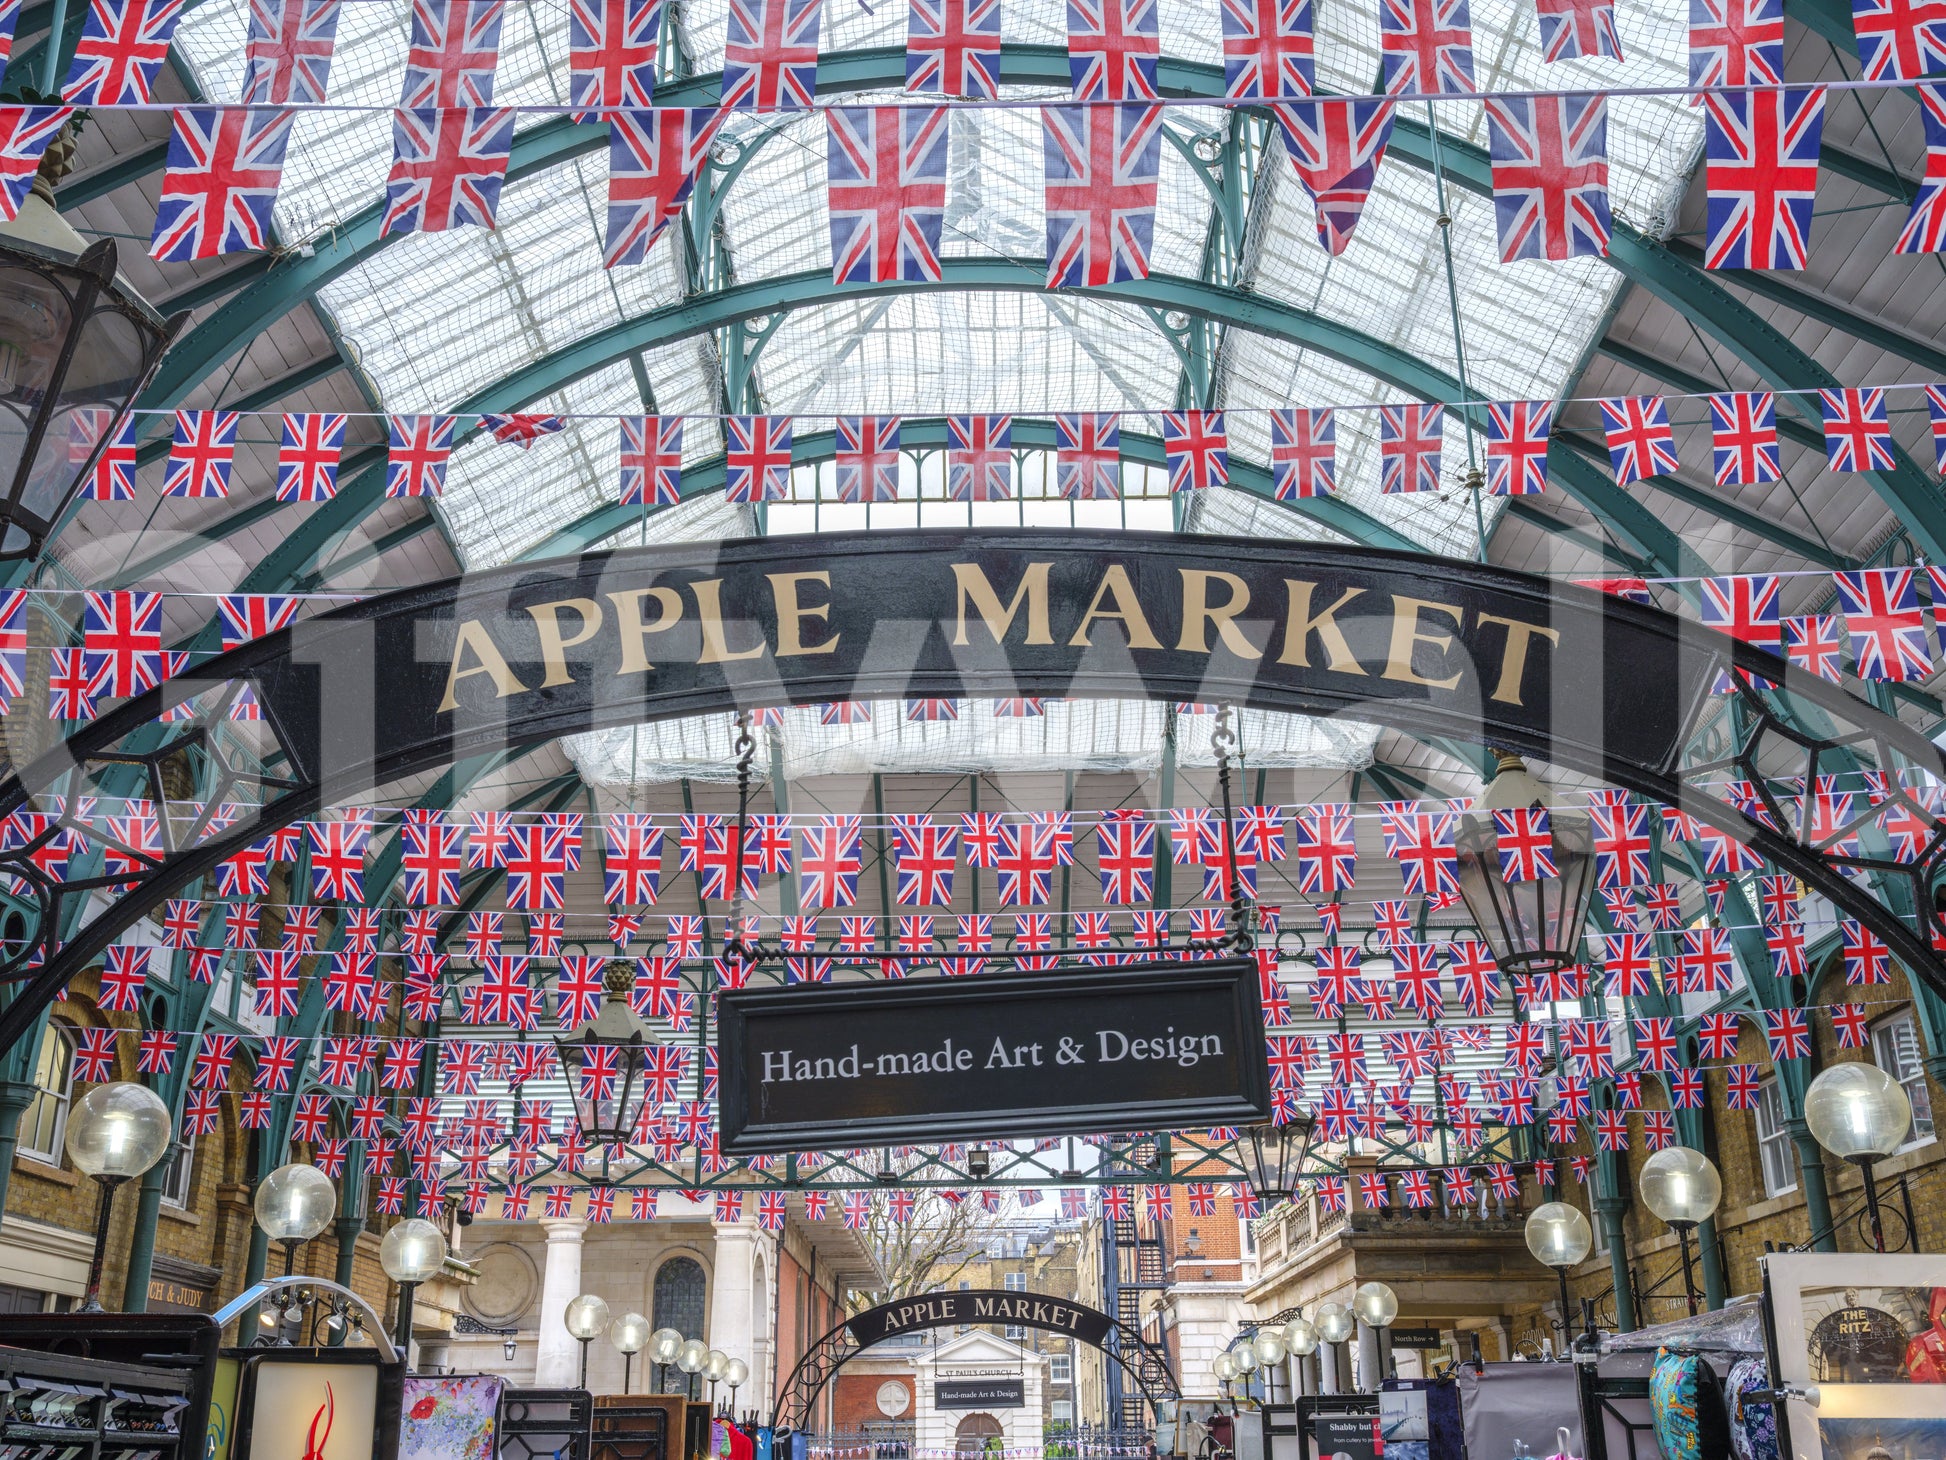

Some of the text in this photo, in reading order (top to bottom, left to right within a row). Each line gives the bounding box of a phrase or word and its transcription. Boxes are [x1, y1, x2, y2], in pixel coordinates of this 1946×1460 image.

[436, 561, 1560, 714] APPLE MARKET
[761, 1026, 1224, 1083] Hand-made Art & Design
[149, 1280, 204, 1308] CH & JUDY
[884, 1297, 1084, 1331] APPLE MARKET
[1841, 1309, 1868, 1320] THE
[1839, 1321, 1872, 1334] RITZ
[941, 1391, 977, 1399] Hand-made
[997, 1390, 1018, 1399] Design
[1329, 1422, 1357, 1432] Shabby
[1359, 1422, 1372, 1431] but
